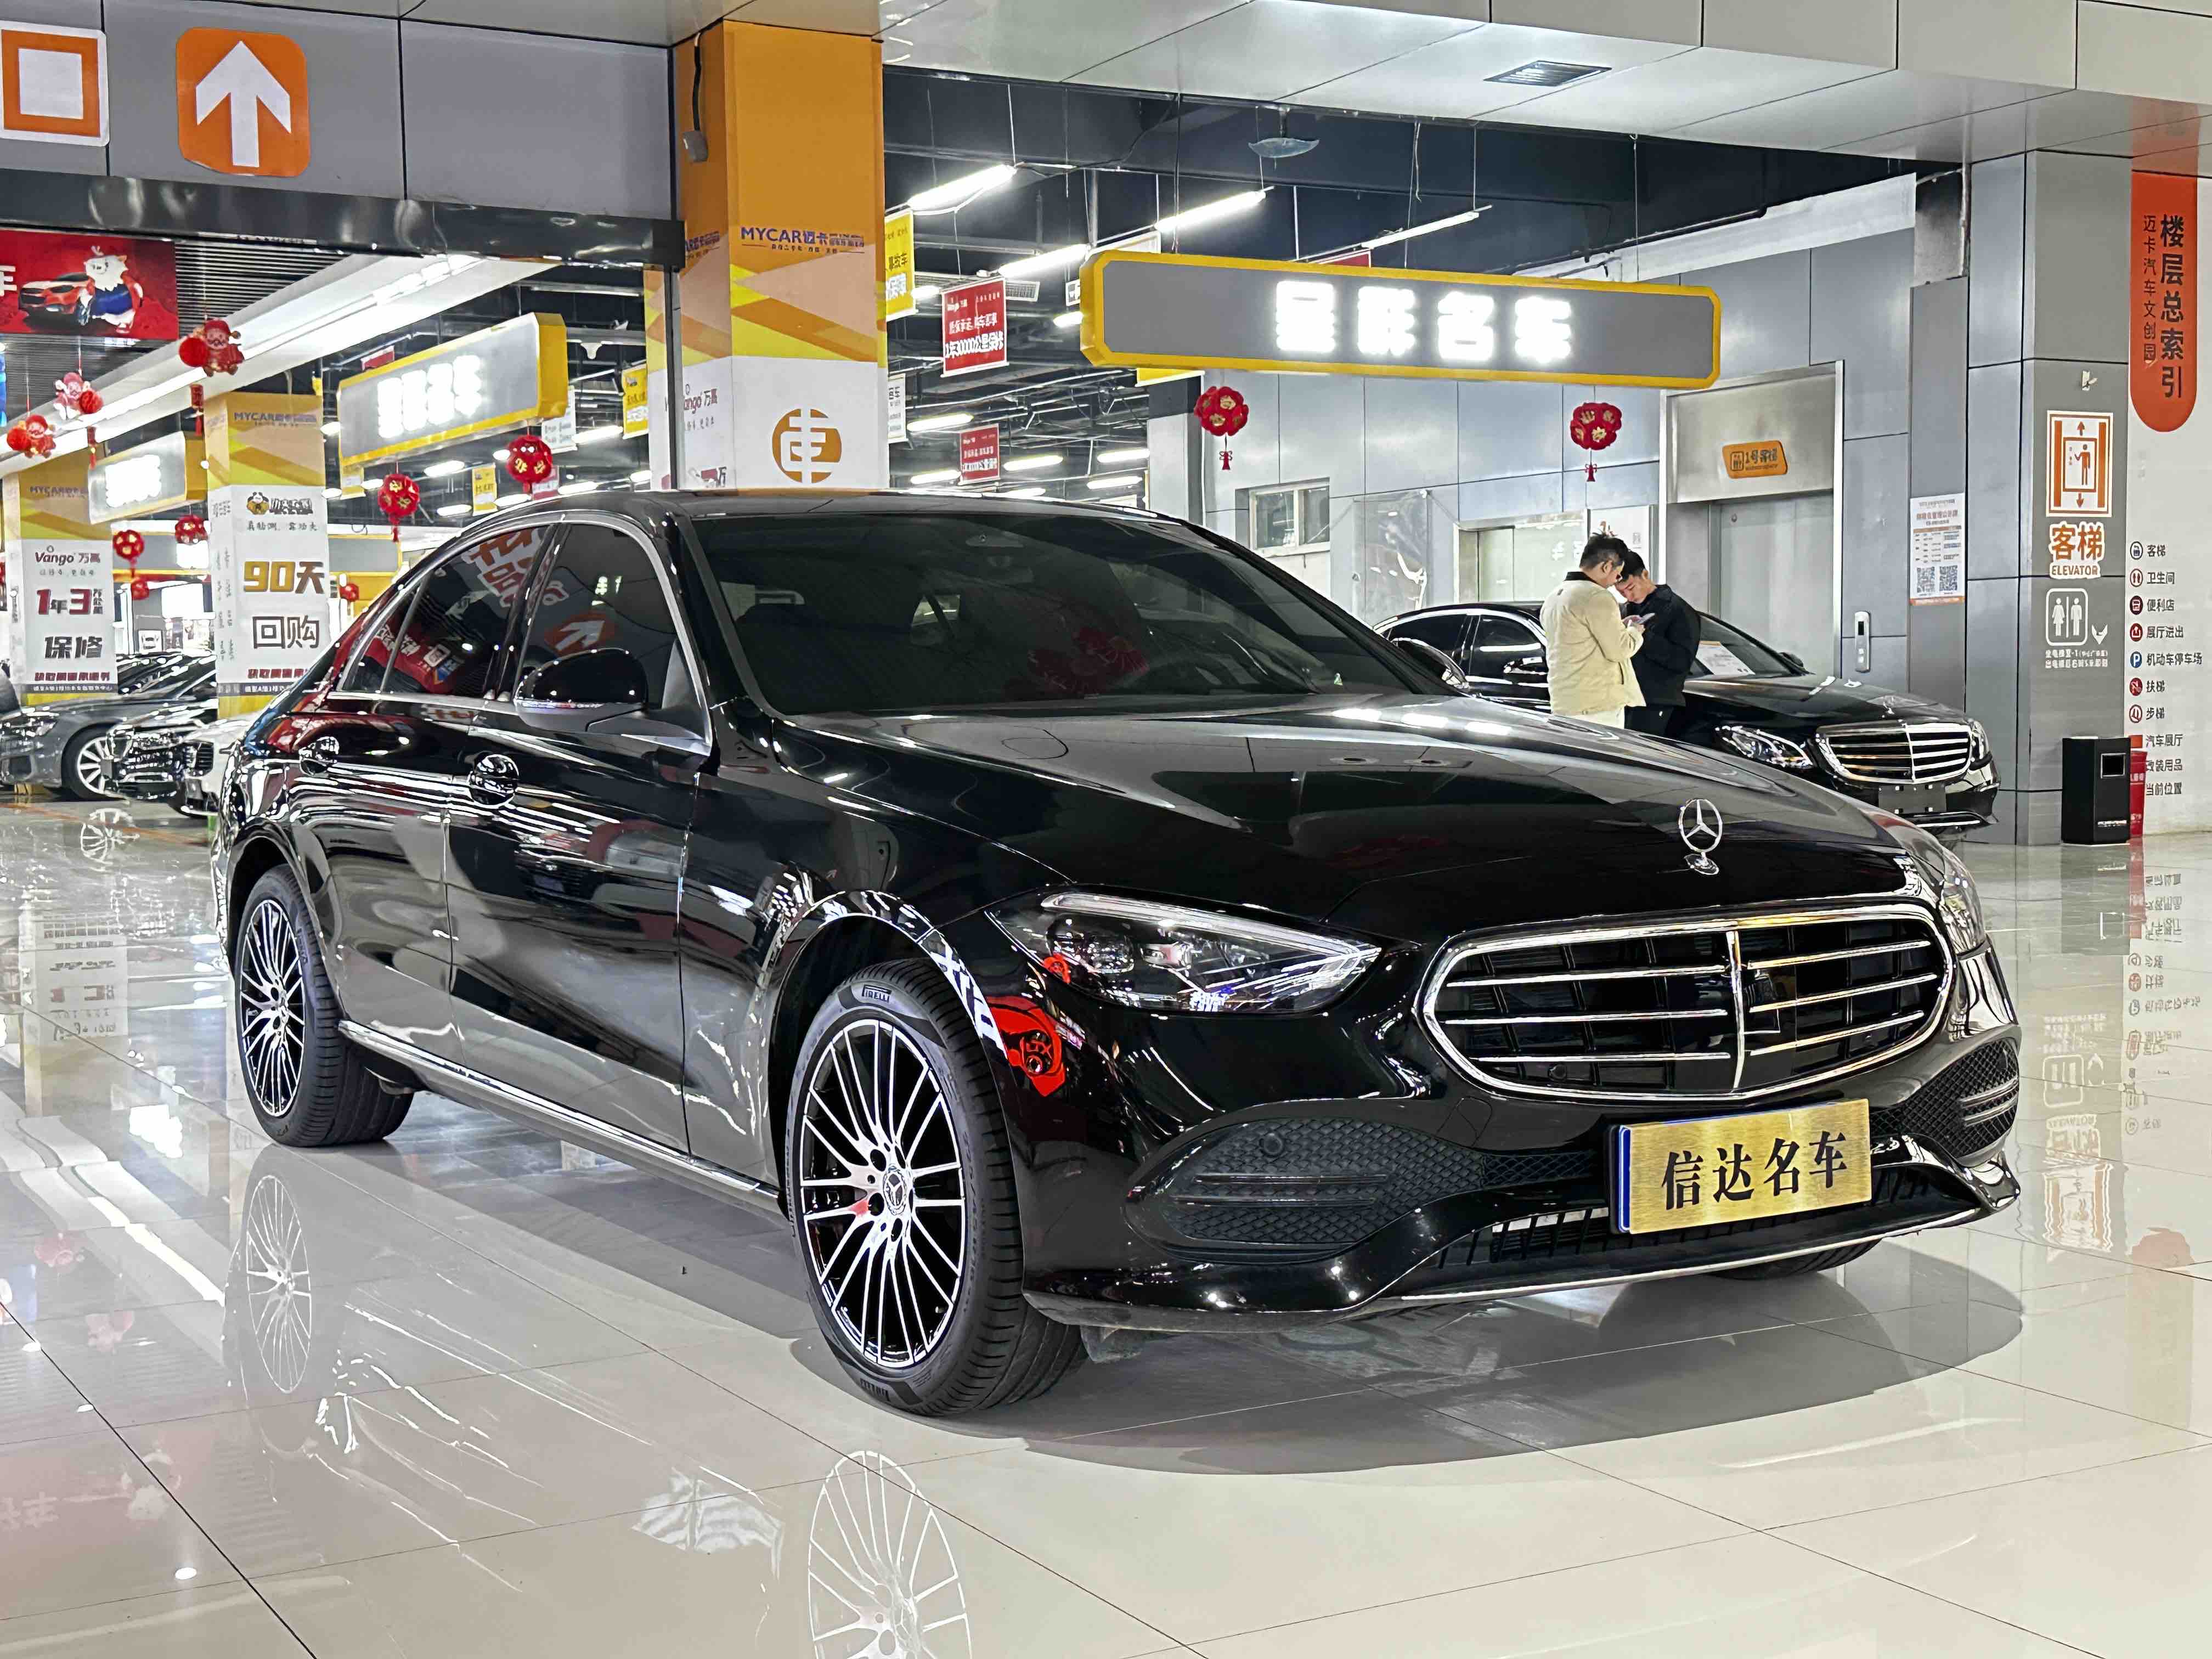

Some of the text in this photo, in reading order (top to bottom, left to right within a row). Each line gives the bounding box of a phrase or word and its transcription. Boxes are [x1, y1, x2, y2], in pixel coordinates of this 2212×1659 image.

[2143, 215, 2157, 361] 迈卡汽车文创园
[2160, 214, 2184, 398] 楼层总索引
[684, 396, 702, 414] ango
[2052, 524, 2102, 560] 客梯
[2147, 544, 2166, 557] 客梯
[35, 552, 74, 566] Vango
[2052, 565, 2098, 575] ELEVATOR
[244, 561, 325, 594] 90天
[2147, 572, 2175, 584] 卫生间
[2147, 599, 2175, 612] 便利店
[252, 615, 319, 649] 回购
[45, 636, 102, 659] 保修
[2147, 653, 2202, 666] 机动车停车场
[2146, 680, 2165, 692] 扶梯
[2146, 707, 2165, 720] 步梯
[2146, 734, 2183, 747] 汽车展厅
[2146, 782, 2182, 795] 当前位置
[862, 985, 891, 1003] PIRELLI
[1661, 1131, 1847, 1210] 信达名车
